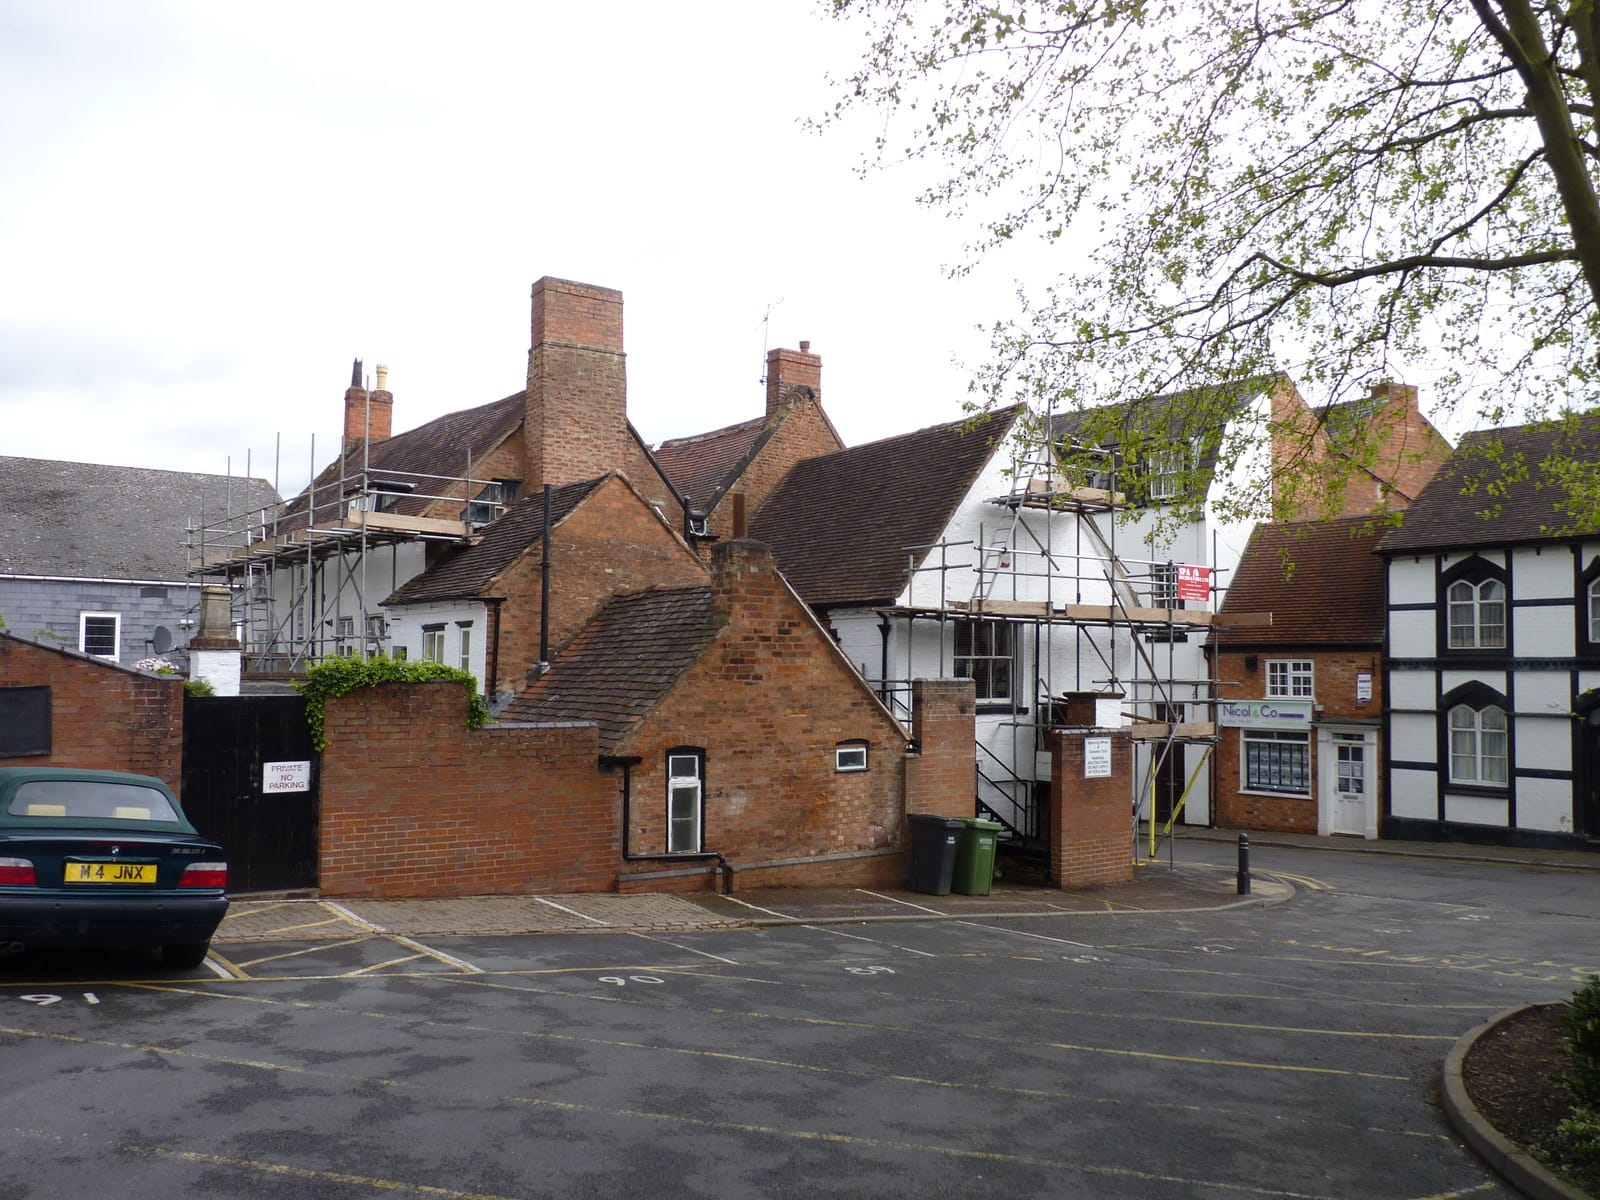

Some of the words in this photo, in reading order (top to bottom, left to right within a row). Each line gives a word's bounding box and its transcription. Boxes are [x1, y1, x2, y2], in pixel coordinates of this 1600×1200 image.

[1223, 704, 1251, 717] Nicol
[1260, 704, 1278, 718] Co
[271, 764, 304, 772] PRIVATE
[280, 773, 294, 781] NO
[269, 781, 304, 789] PARKING
[113, 865, 144, 879] JNX
[598, 975, 665, 986] 90
[19, 992, 100, 1006] 91
